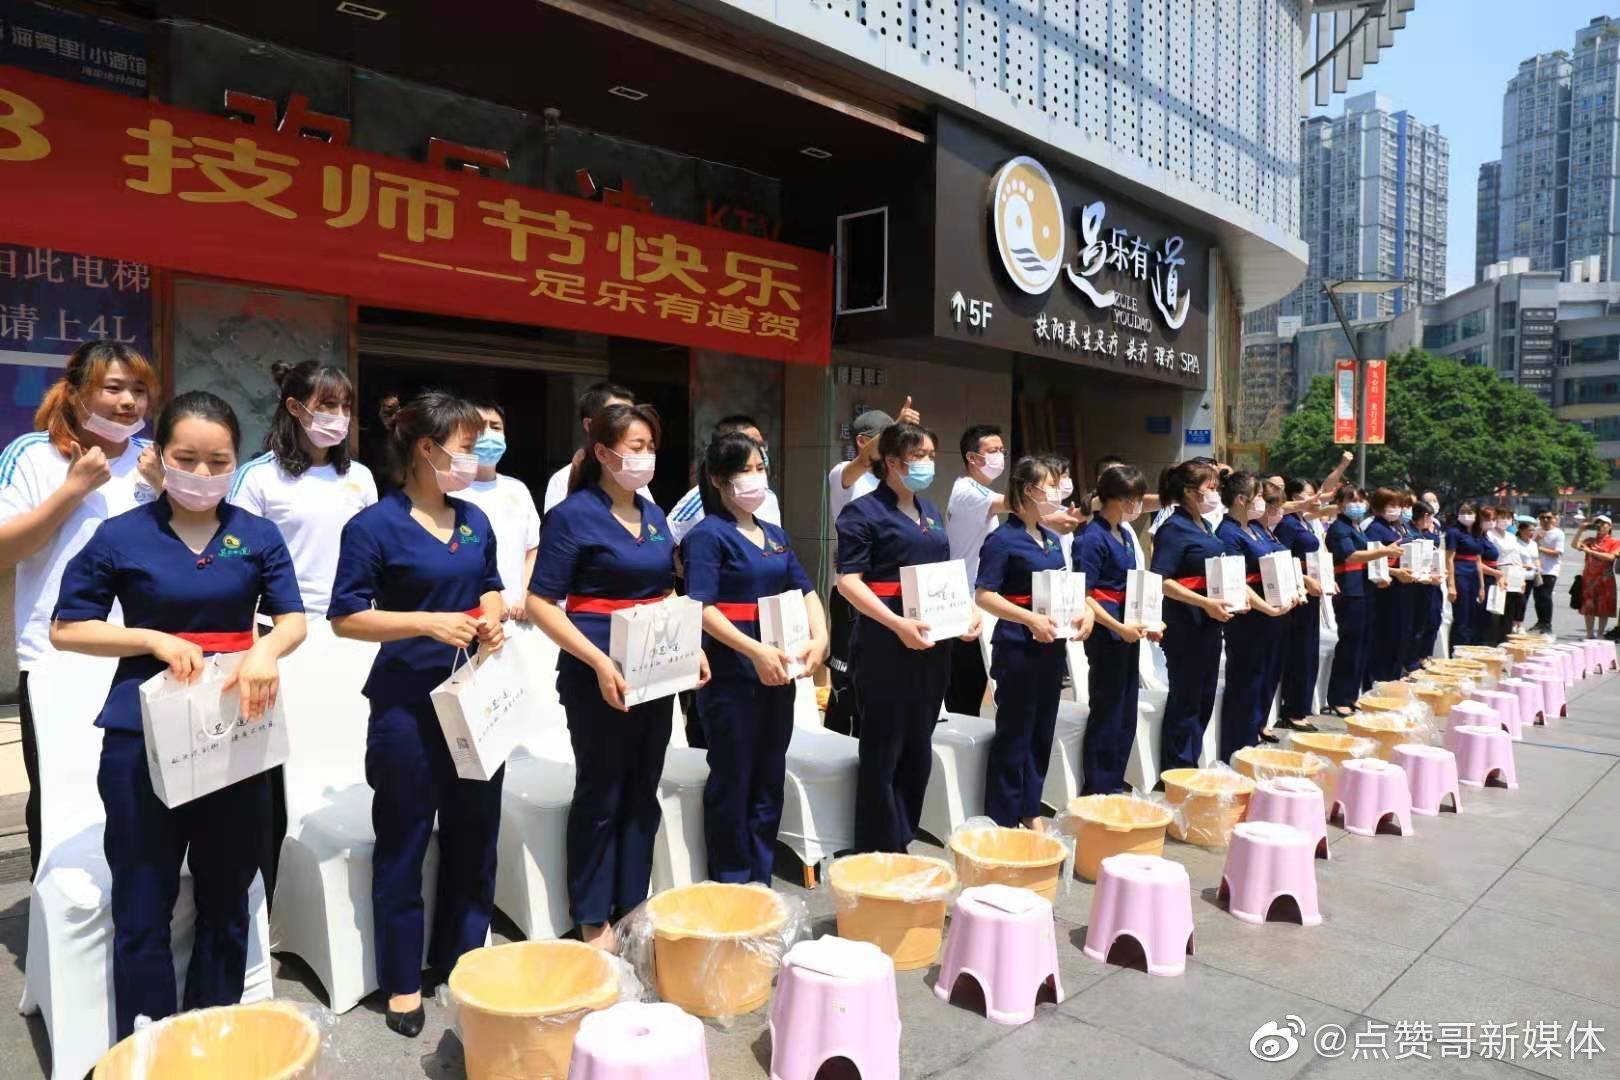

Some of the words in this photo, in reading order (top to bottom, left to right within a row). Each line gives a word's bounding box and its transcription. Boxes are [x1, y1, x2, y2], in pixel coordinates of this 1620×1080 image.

[122, 118, 801, 312] 技师节快乐
[967, 299, 993, 328] 5F
[1180, 351, 1200, 374] SPA
